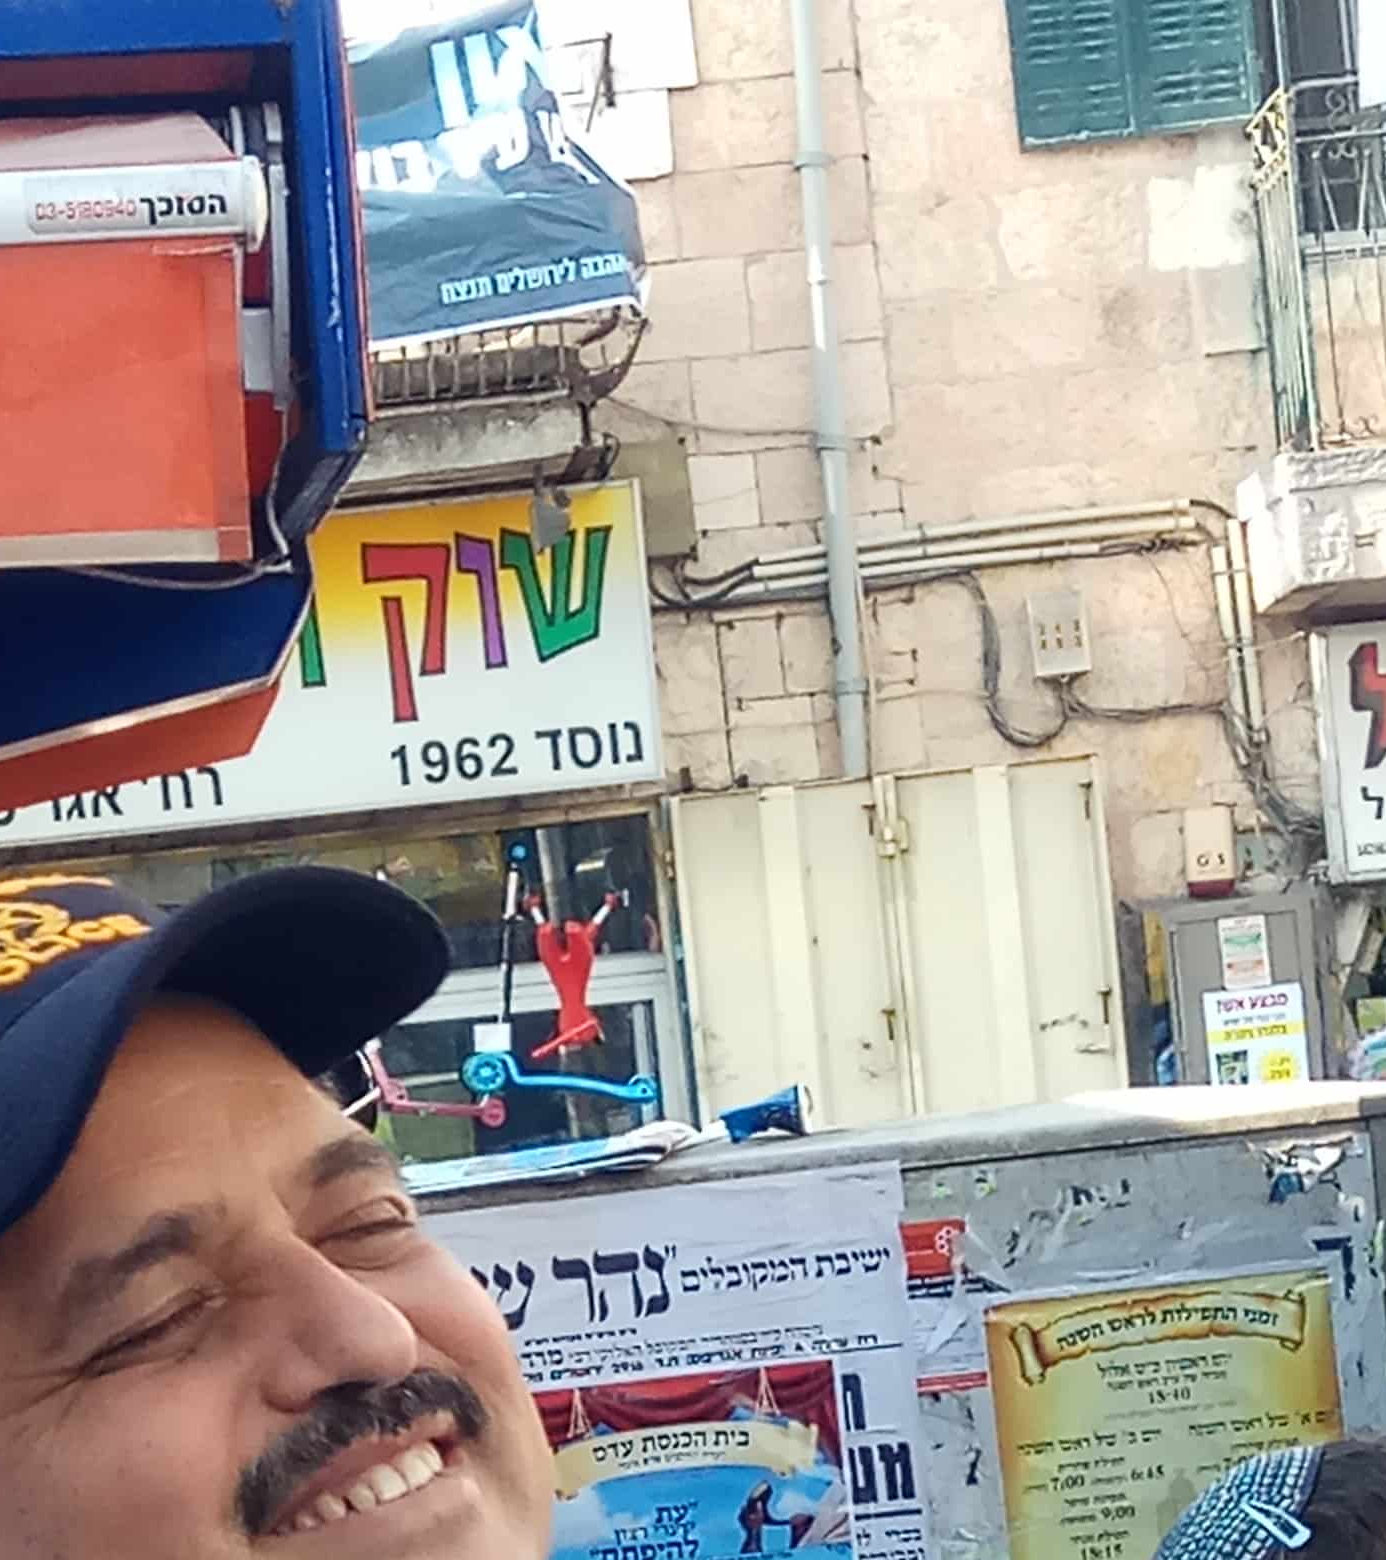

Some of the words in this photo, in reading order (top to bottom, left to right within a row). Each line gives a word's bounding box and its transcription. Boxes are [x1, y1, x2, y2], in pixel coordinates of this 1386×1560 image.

[495, 258, 576, 294] לירושלים
[360, 525, 613, 722] שוק
[390, 732, 518, 786] 1962
[535, 720, 644, 771] נוסד
[680, 1256, 809, 1294] המקובלים
[815, 1246, 891, 1278] ישיבת
[1111, 1308, 1156, 1333] לראש
[1162, 1303, 1238, 1326] התפילות
[1242, 1308, 1279, 1327] זמני
[1056, 1322, 1103, 1351] השנה
[642, 1433, 709, 1452] הכנסת
[712, 1430, 751, 1448] בית
